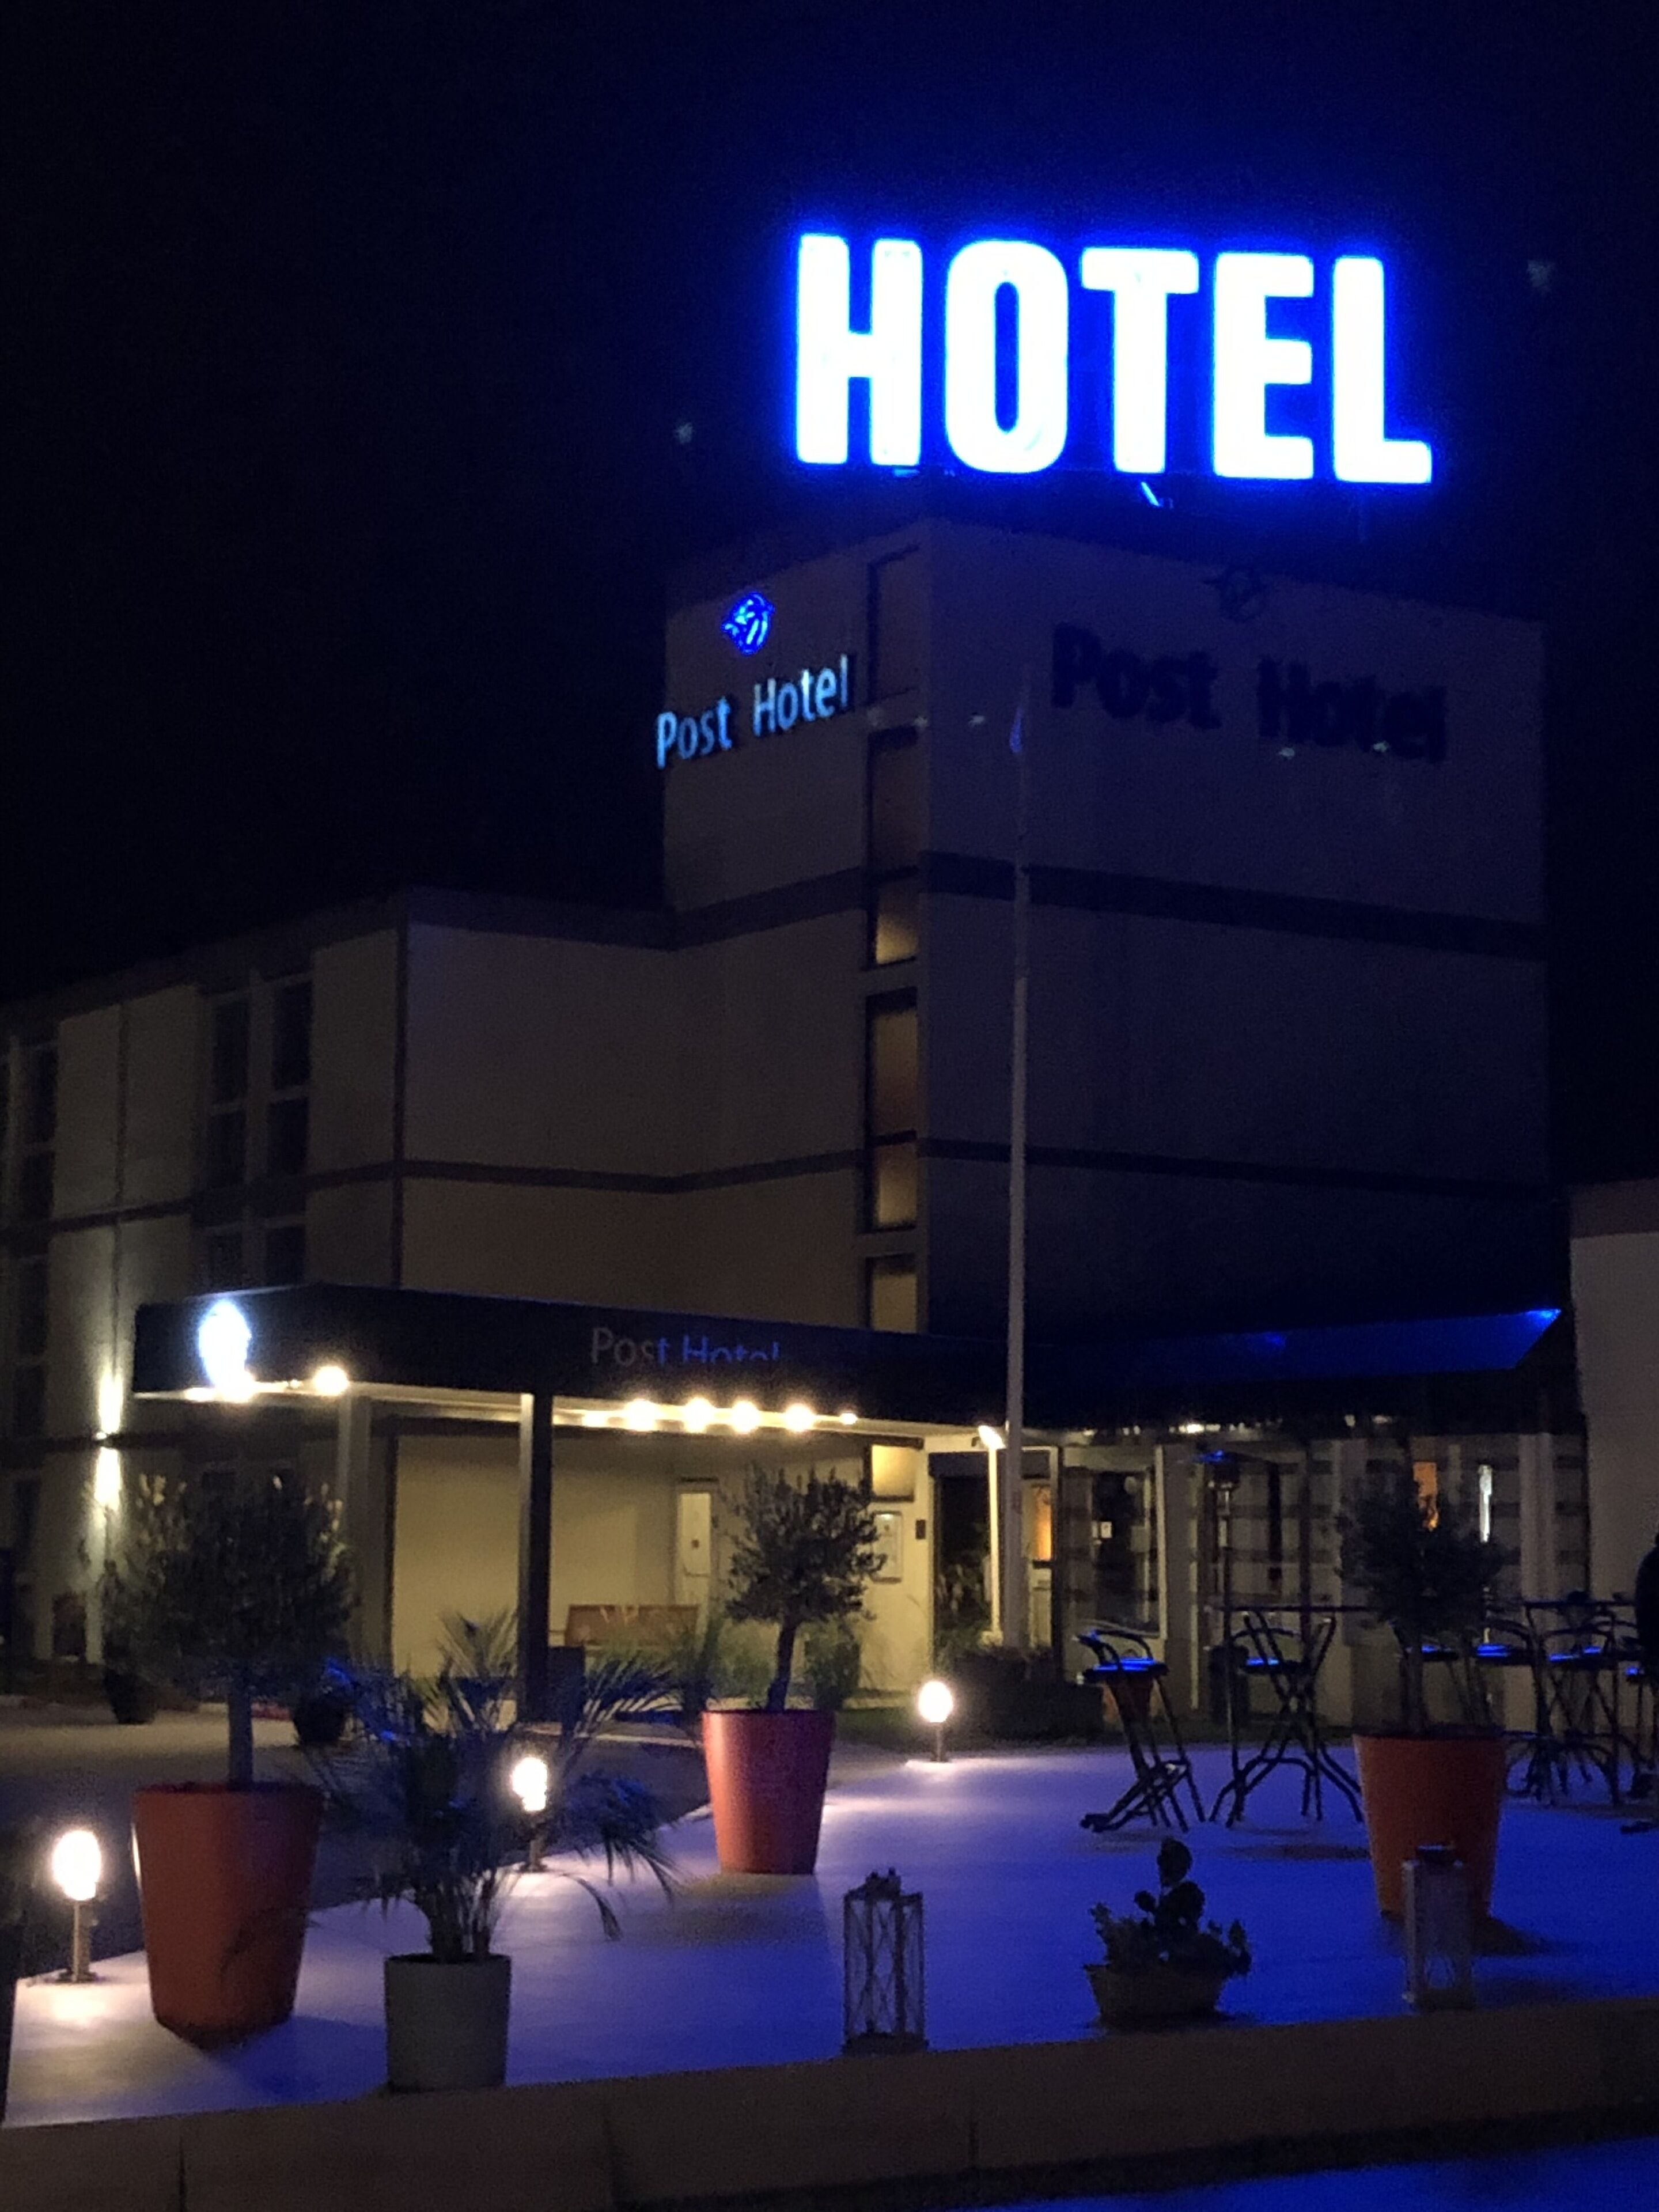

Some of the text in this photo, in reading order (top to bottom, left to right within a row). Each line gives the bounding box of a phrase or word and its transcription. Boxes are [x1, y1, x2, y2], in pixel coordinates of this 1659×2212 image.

[796, 233, 1433, 485] HOTEL
[656, 653, 850, 770] Post Hotel
[1053, 622, 1445, 763] Post Hotel
[590, 1326, 669, 1368] Post
